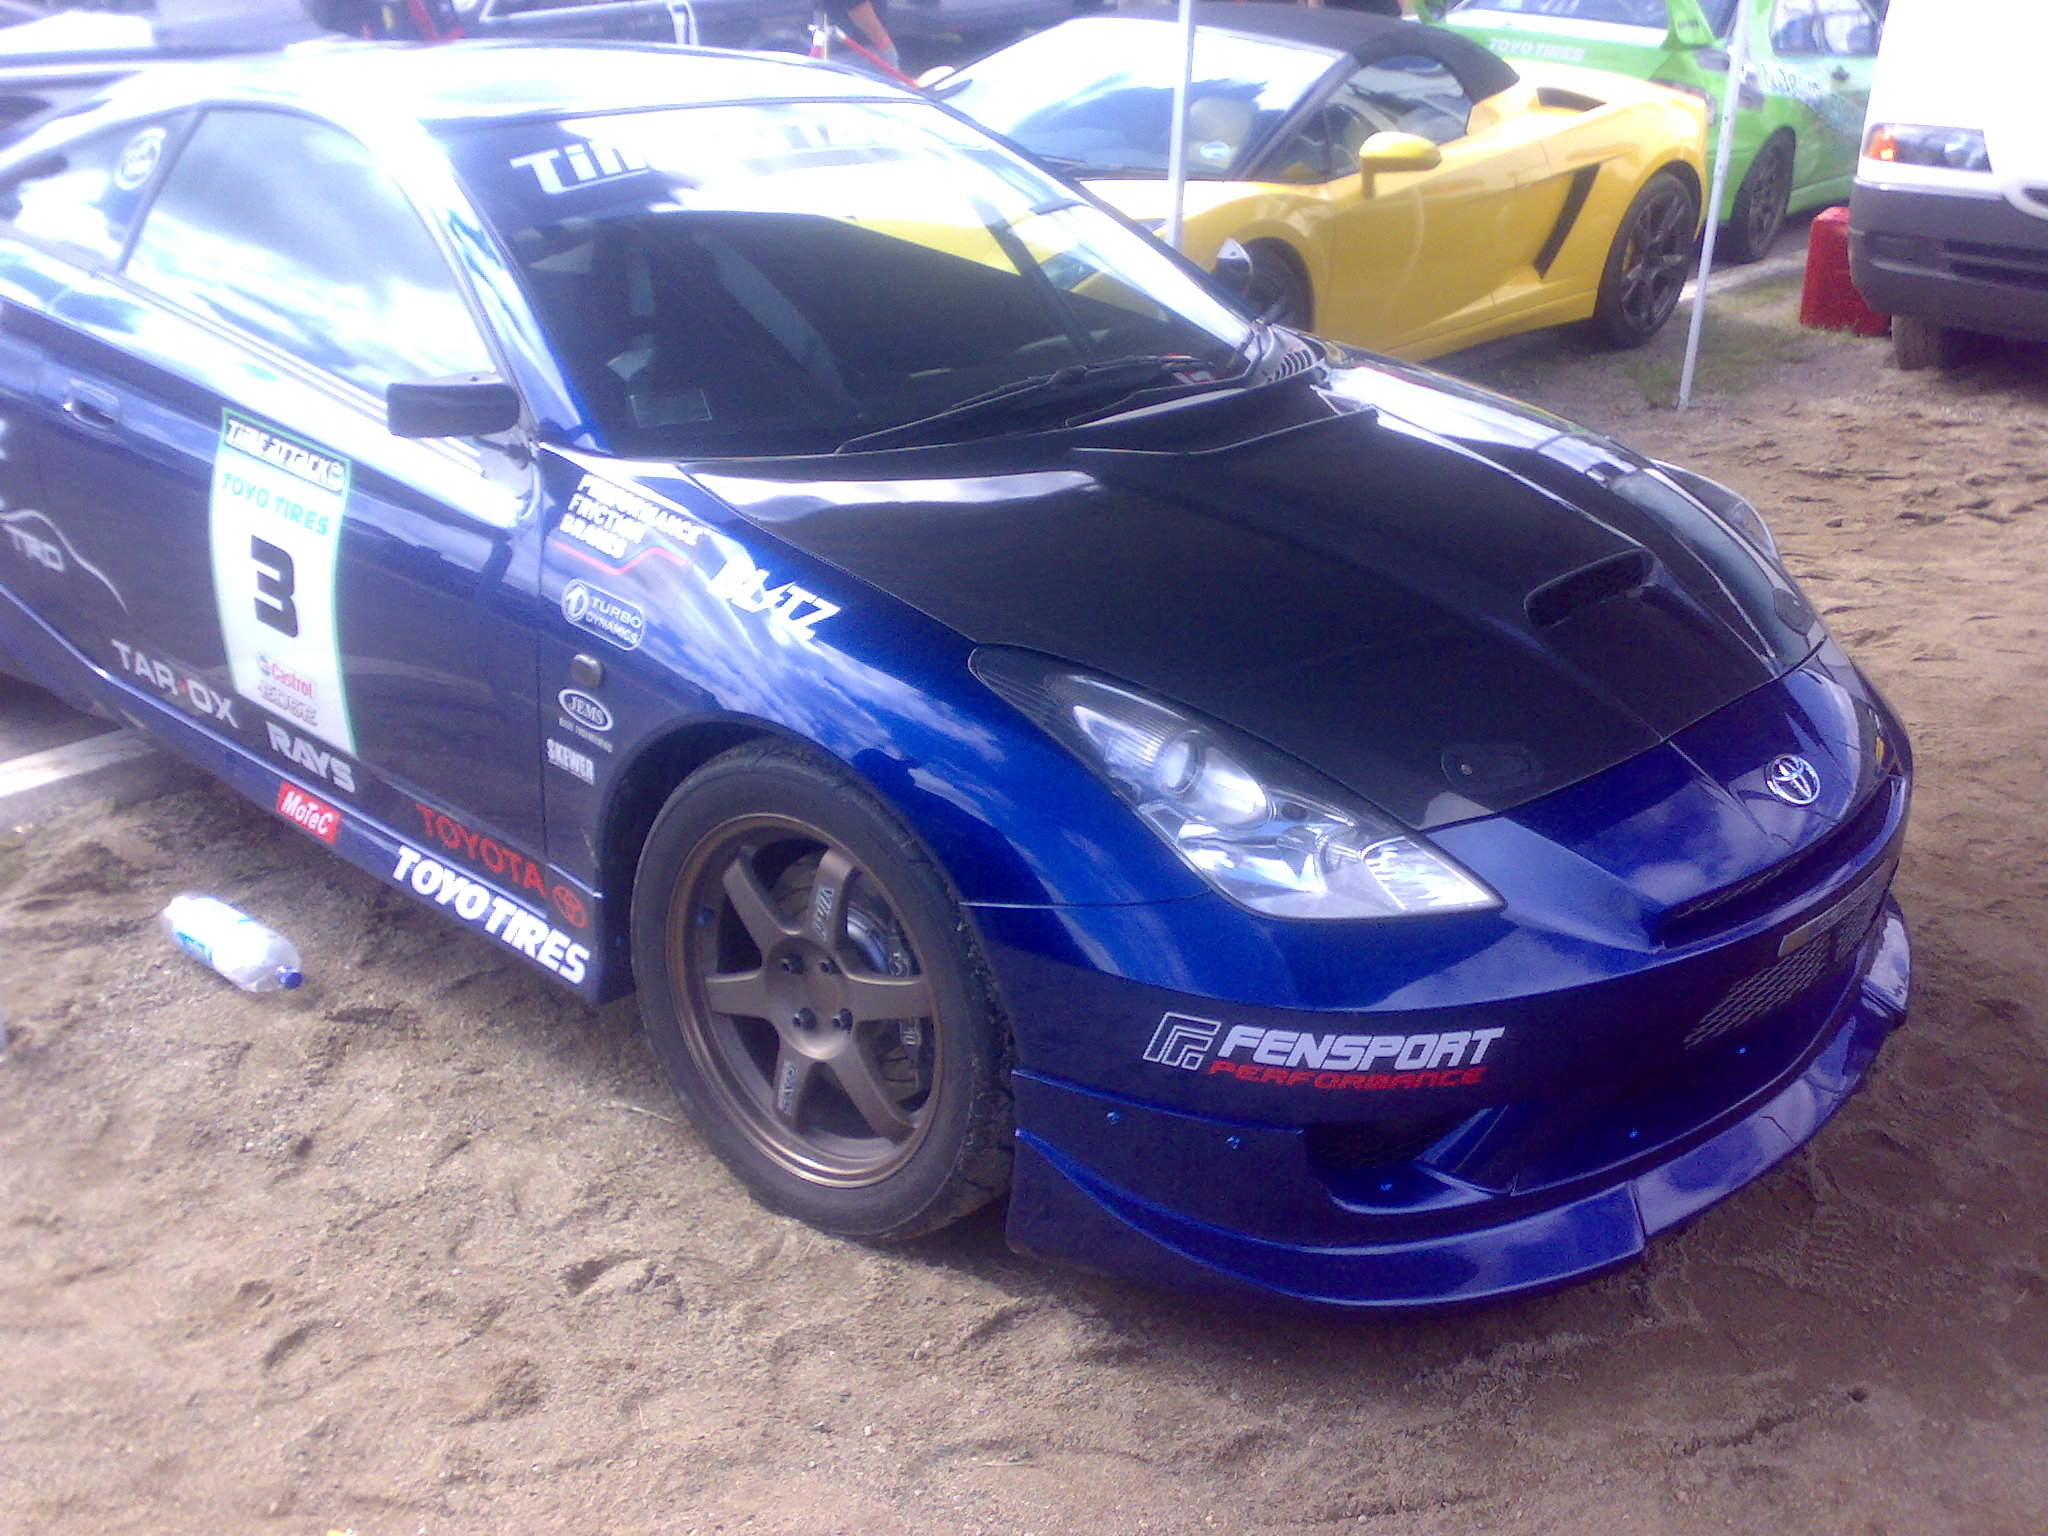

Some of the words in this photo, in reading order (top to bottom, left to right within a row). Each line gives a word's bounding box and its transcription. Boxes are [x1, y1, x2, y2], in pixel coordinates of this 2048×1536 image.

[1488, 38, 1533, 55] TOYO
[222, 472, 270, 508] TOYO
[274, 495, 331, 535] TIRES
[250, 534, 298, 639] 3
[585, 610, 639, 644] DYNAMICS
[591, 596, 642, 629] TURBO
[271, 662, 314, 699] Castrol
[566, 695, 604, 725] JEMS
[265, 720, 355, 793] RAYS
[280, 790, 334, 835] MoTeC
[416, 803, 548, 897] TOYOTA
[393, 844, 490, 921] TOYO
[484, 896, 590, 984] TIRES
[1217, 1024, 1505, 1073] FENSPORT
[1208, 1060, 1488, 1091] PERFORMANCE
